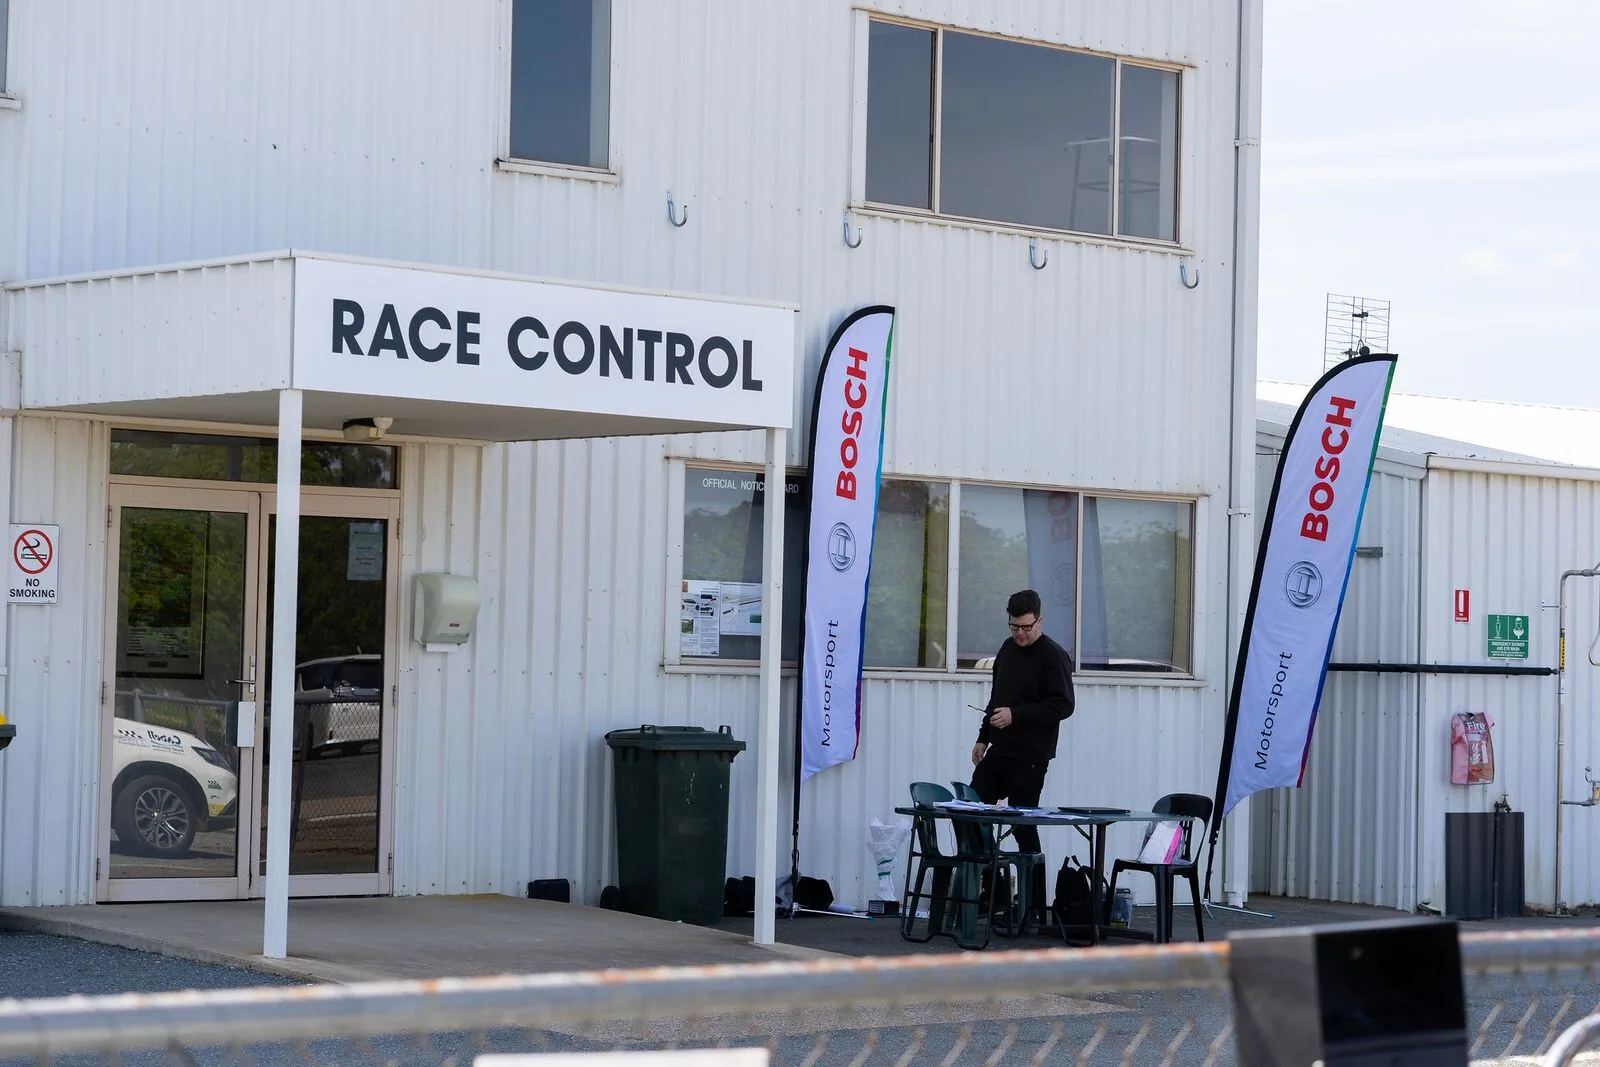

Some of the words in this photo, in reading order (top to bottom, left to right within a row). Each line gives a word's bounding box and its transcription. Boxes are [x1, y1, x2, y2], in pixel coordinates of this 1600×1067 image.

[332, 298, 481, 366] RACE
[507, 316, 763, 392] CONTROL
[835, 347, 868, 501] BOSCH
[1300, 396, 1356, 541] BOSCH
[702, 478, 737, 489] OFFICIAL
[741, 481, 765, 491] NOTIC
[785, 484, 799, 493] ARD
[9, 588, 55, 598] SMOKING
[25, 578, 40, 587] NO
[820, 619, 839, 747] Motorsport
[1254, 651, 1293, 771] Motorsport
[1466, 720, 1486, 730] Fire
